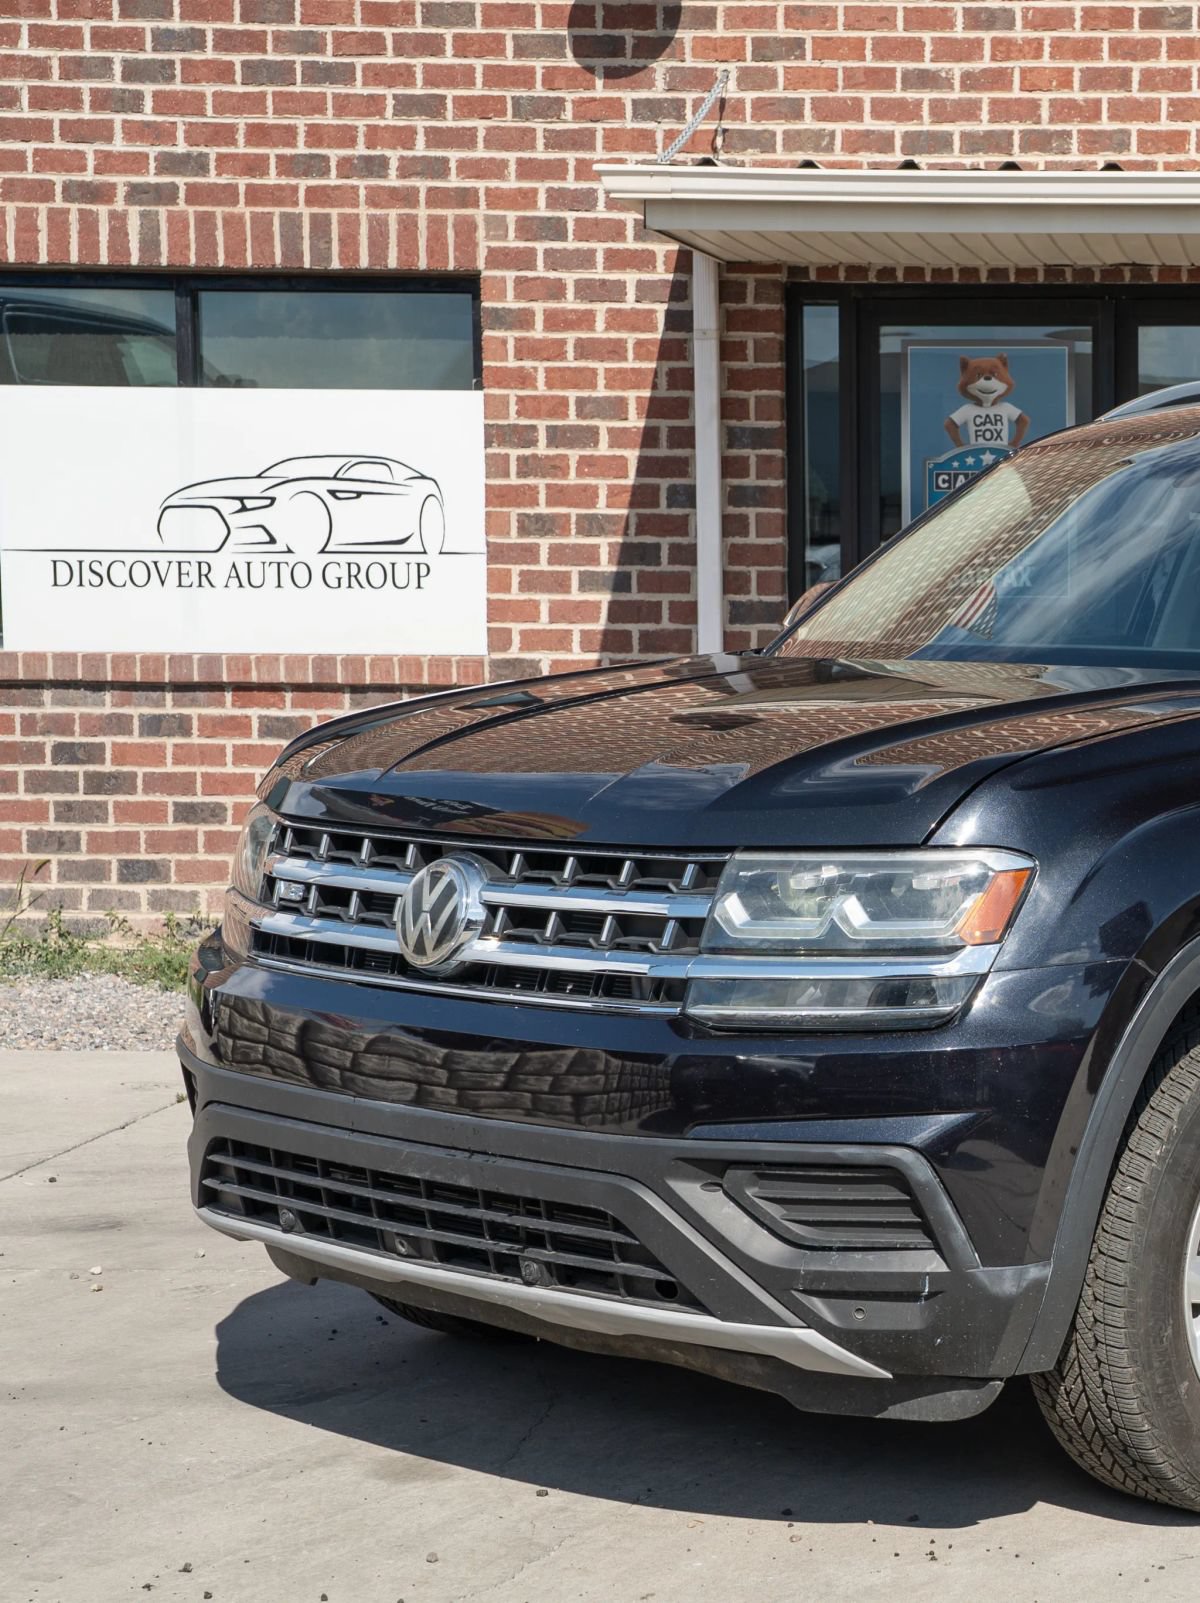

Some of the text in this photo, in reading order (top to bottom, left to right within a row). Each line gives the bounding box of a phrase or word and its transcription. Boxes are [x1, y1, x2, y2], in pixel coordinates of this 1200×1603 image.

[972, 413, 1004, 428] CAR
[974, 428, 1004, 443] FOX
[51, 559, 431, 590] DISCOVER AUTO GROUP
